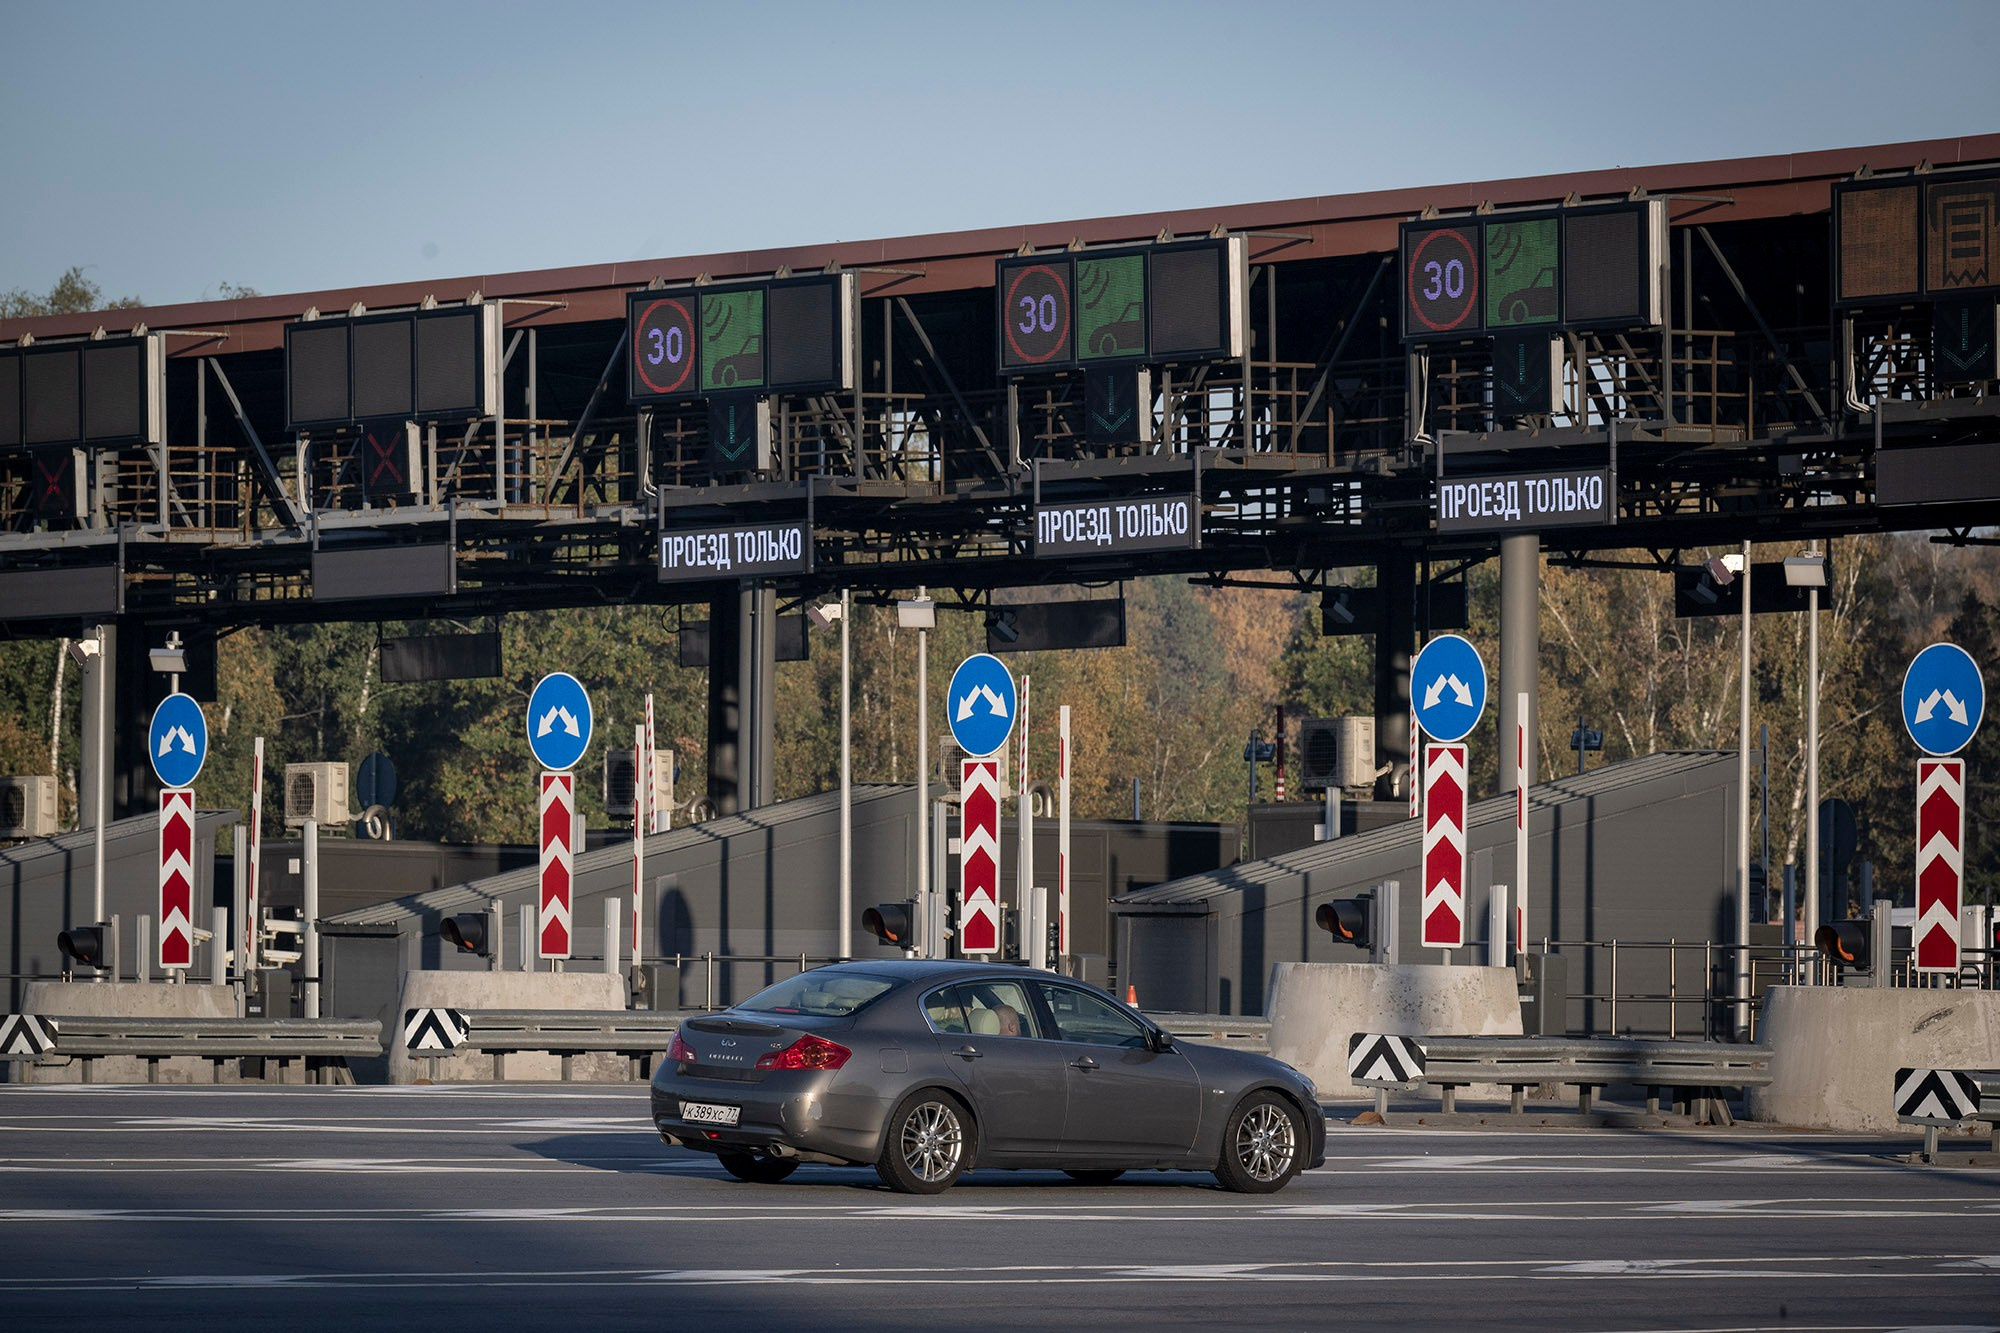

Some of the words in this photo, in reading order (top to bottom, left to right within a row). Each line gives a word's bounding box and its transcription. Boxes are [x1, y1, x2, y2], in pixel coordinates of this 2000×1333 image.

[1424, 258, 1464, 301] 30
[1018, 293, 1056, 334] 30
[647, 326, 683, 365] 30
[1441, 481, 1521, 521] ПРОЕЗД
[1524, 475, 1603, 514] ТОЛЬКО
[1038, 507, 1112, 546] ПРОЕЗД
[1115, 501, 1188, 539] ТОЛЬКО
[662, 533, 731, 571] ПРОЕЗД
[734, 528, 801, 564] ТОЛЬКО
